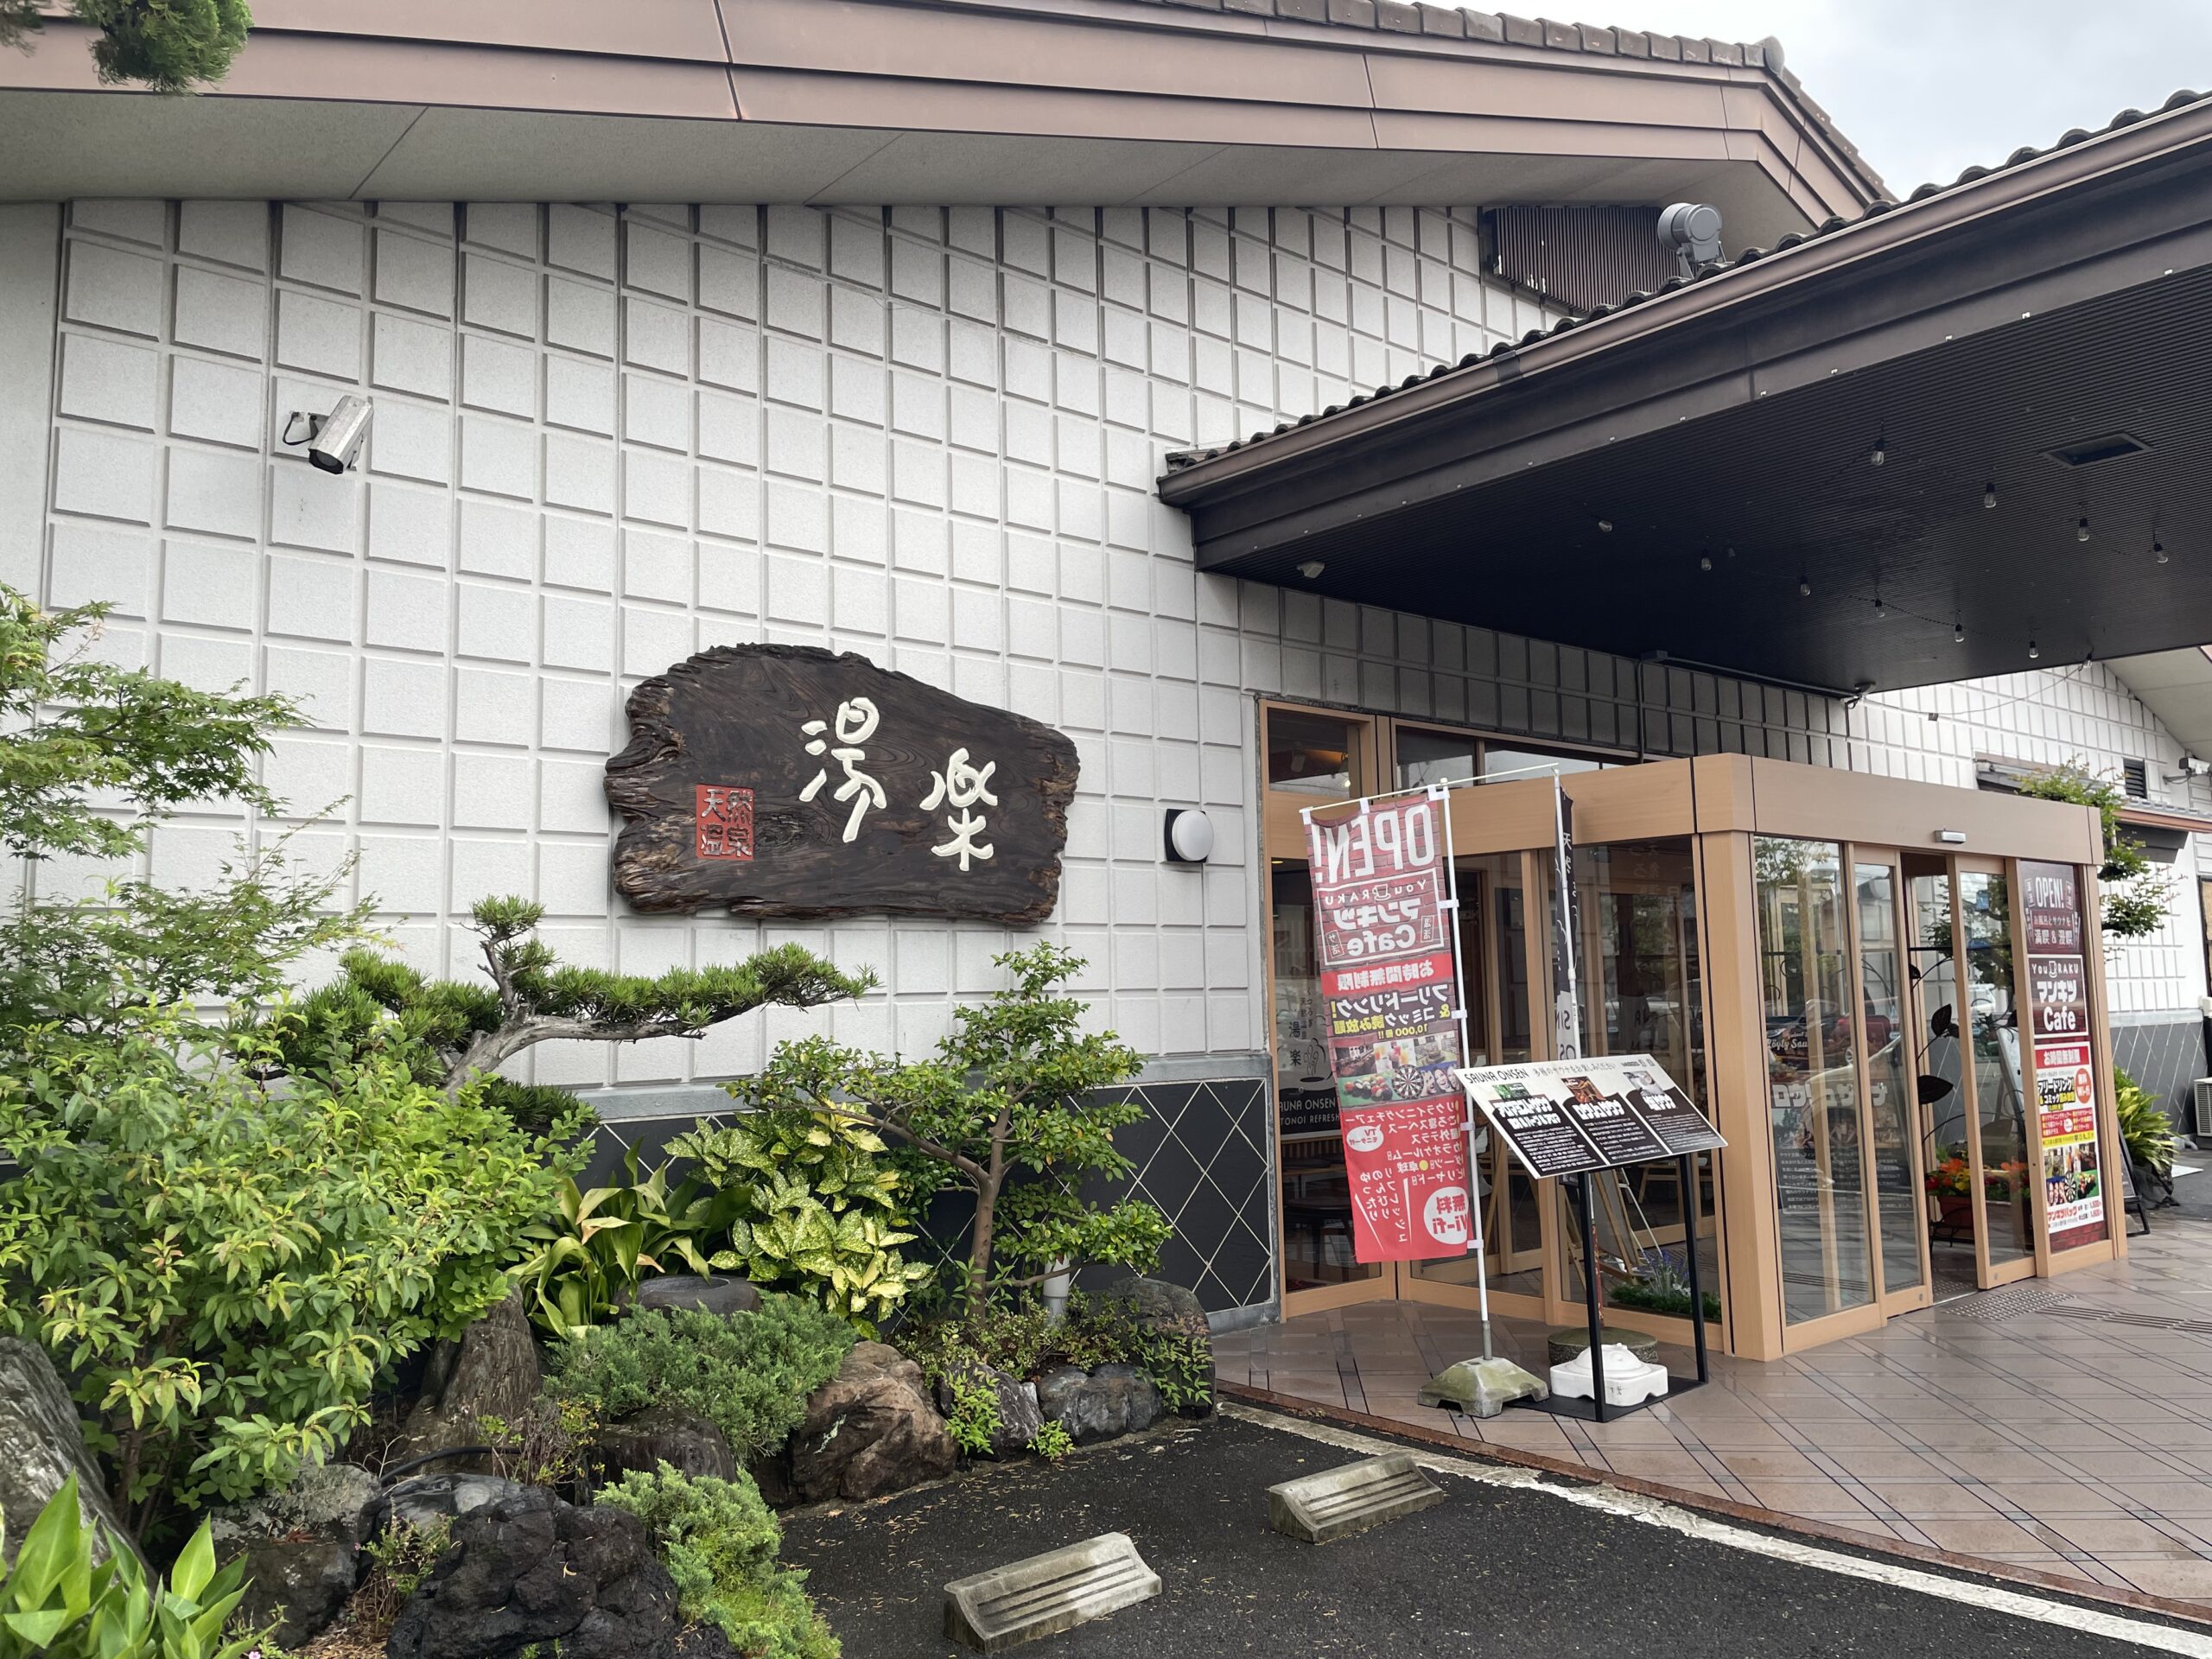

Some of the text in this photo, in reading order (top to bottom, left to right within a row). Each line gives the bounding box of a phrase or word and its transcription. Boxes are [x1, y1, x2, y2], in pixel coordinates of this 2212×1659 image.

[2035, 876, 2065, 909] OPEN!
[2057, 963, 2079, 974] RAKU
[2037, 980, 2078, 1003] マンキツ
[2044, 1007, 2076, 1032] Cafe
[1465, 1071, 1497, 1084] SAUNA
[1497, 1068, 1529, 1082] ONSEN
[1279, 1097, 1336, 1112] AUNA ONSEN
